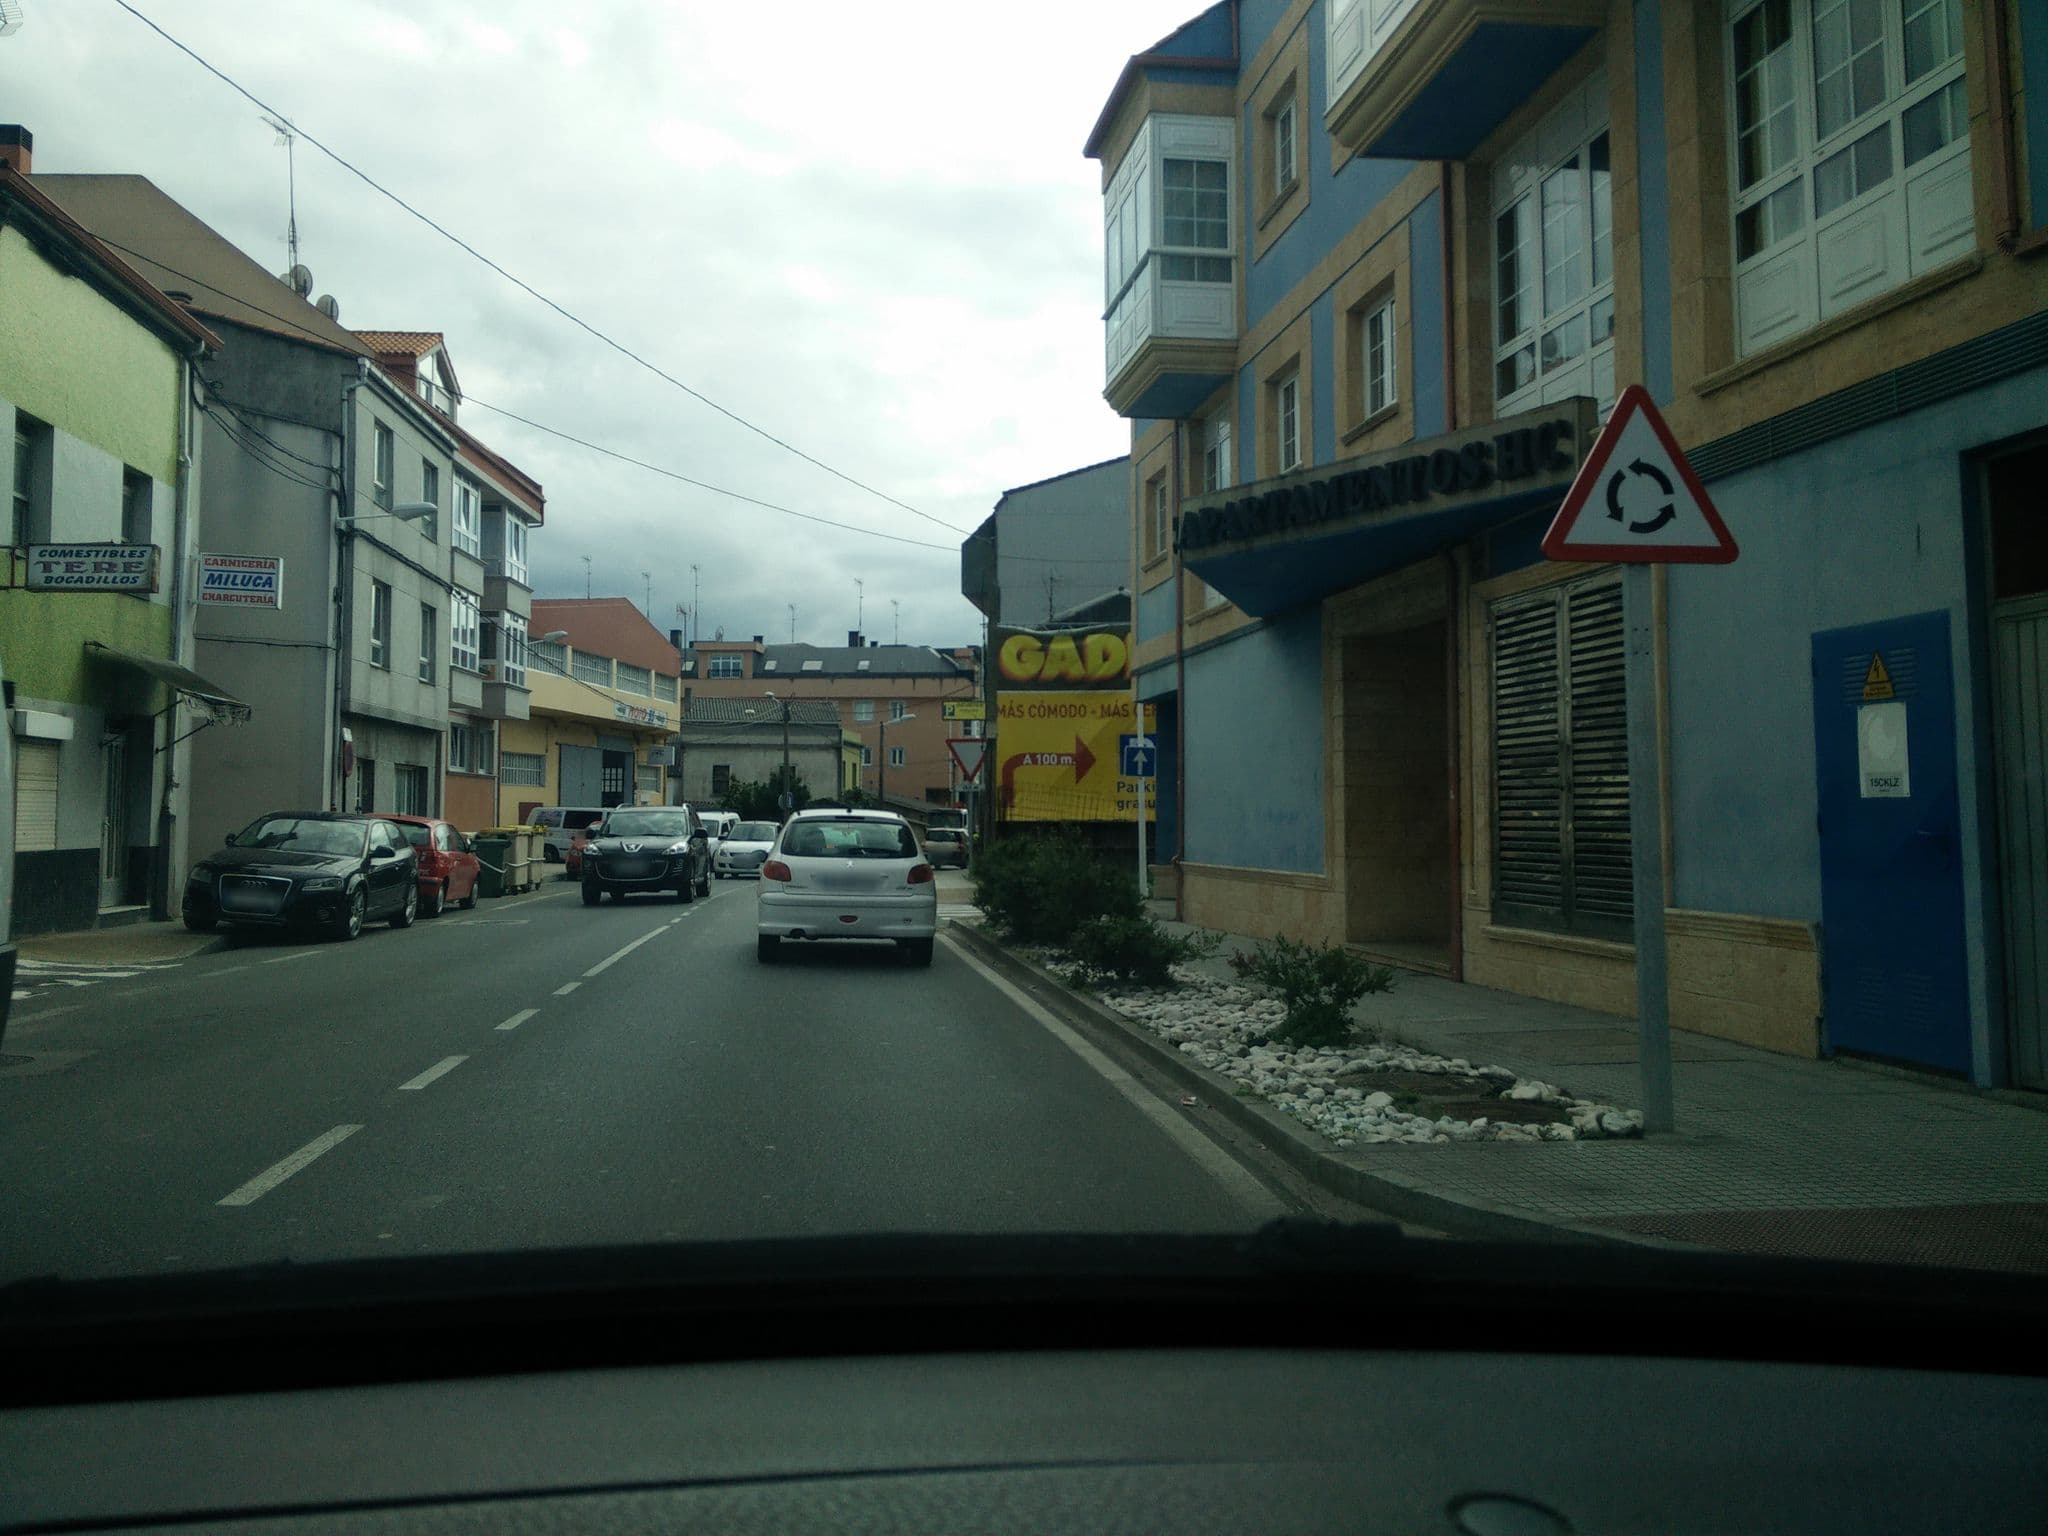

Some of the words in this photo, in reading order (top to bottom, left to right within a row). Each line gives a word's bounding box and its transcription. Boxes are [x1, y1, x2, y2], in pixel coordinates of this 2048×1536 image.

[1180, 441, 1495, 549] APARTAMENTOS
[38, 549, 147, 558] COMESTIBLES
[34, 561, 147, 574] TERE
[43, 576, 140, 585] BOCADILLOS
[998, 633, 1131, 682] GAD
[997, 699, 1024, 718] MÁS
[1028, 699, 1087, 718] CÓMODO
[1101, 699, 1129, 718] MÁS
[1022, 754, 1033, 765] A
[1036, 754, 1058, 765] 100
[1060, 755, 1077, 765] m.
